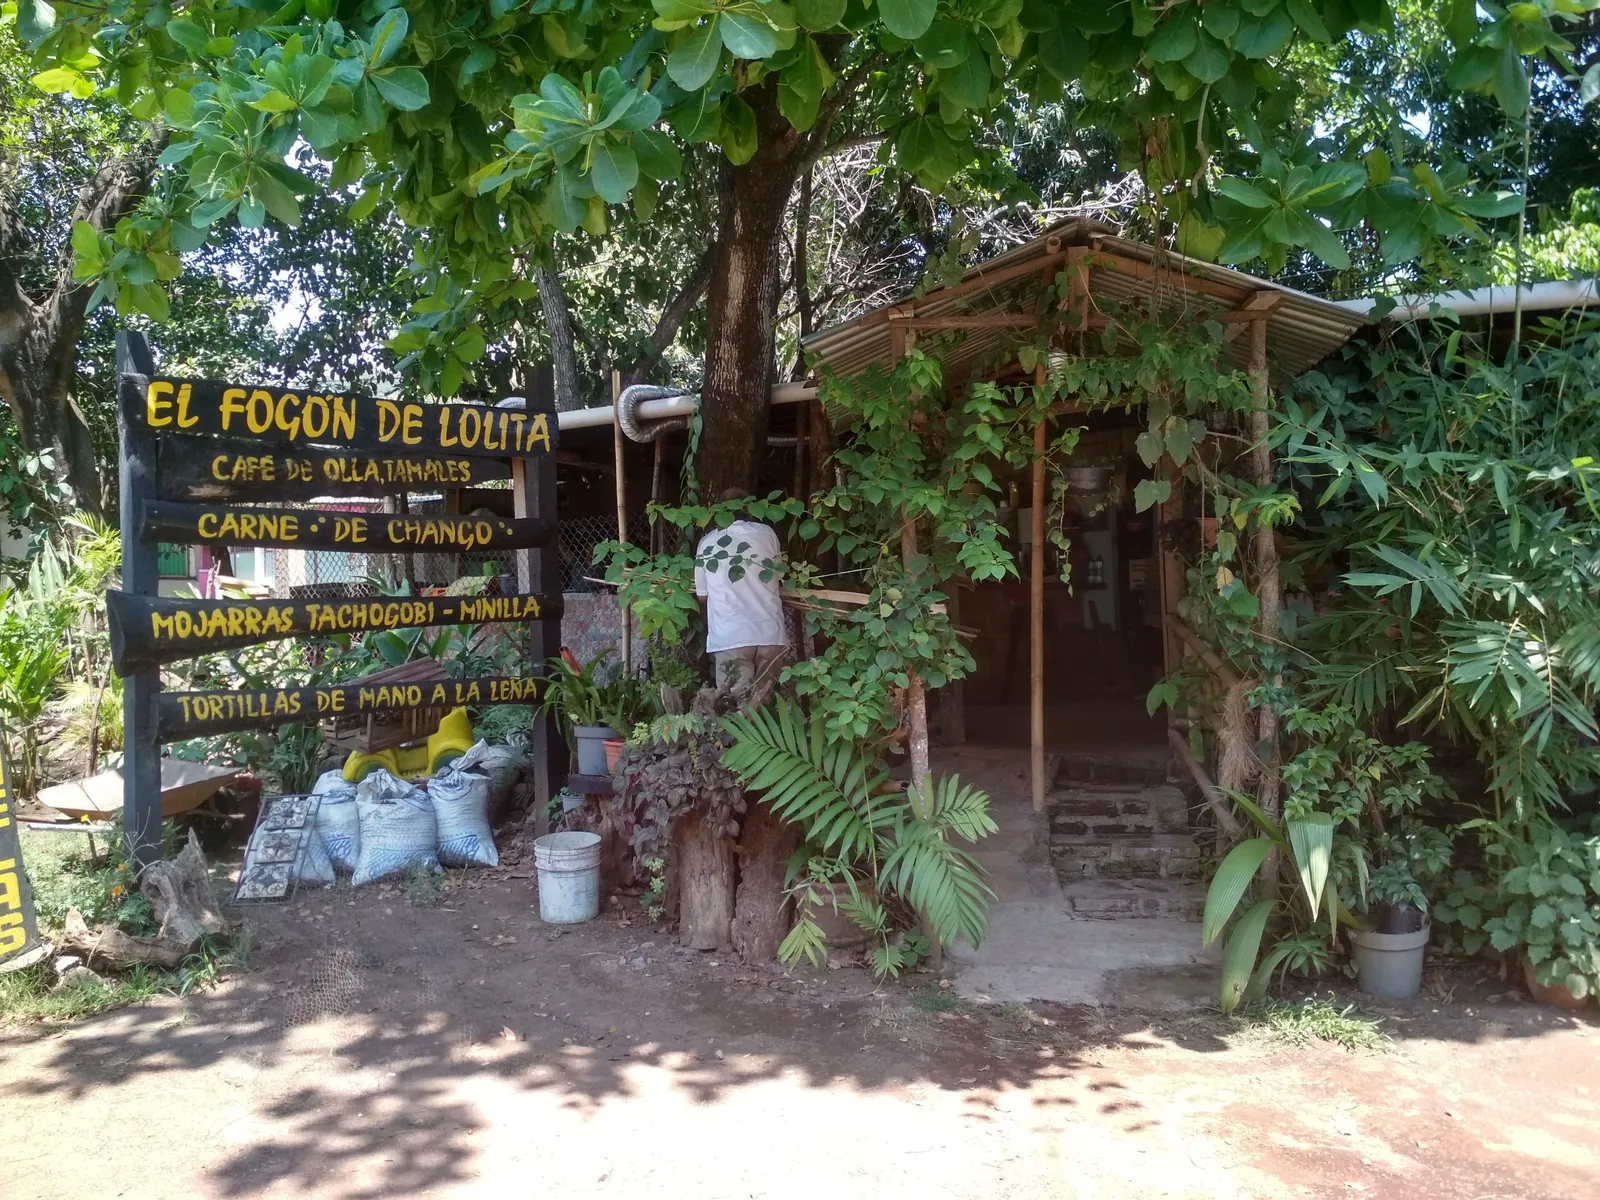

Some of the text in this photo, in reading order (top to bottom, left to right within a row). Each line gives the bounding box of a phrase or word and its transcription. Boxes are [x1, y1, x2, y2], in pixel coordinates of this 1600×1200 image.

[147, 381, 199, 428] EL
[376, 400, 424, 445] DE
[439, 407, 550, 452] LOLITA
[285, 458, 313, 482] DE
[198, 513, 493, 550] CARNE DE CHANGO
[151, 606, 294, 639] MOJARRAS
[305, 601, 434, 629] TACHOGOBI
[459, 596, 540, 621] MINILLA
[177, 676, 537, 722] TORTILLAS DE MANO A LA LEÑA
